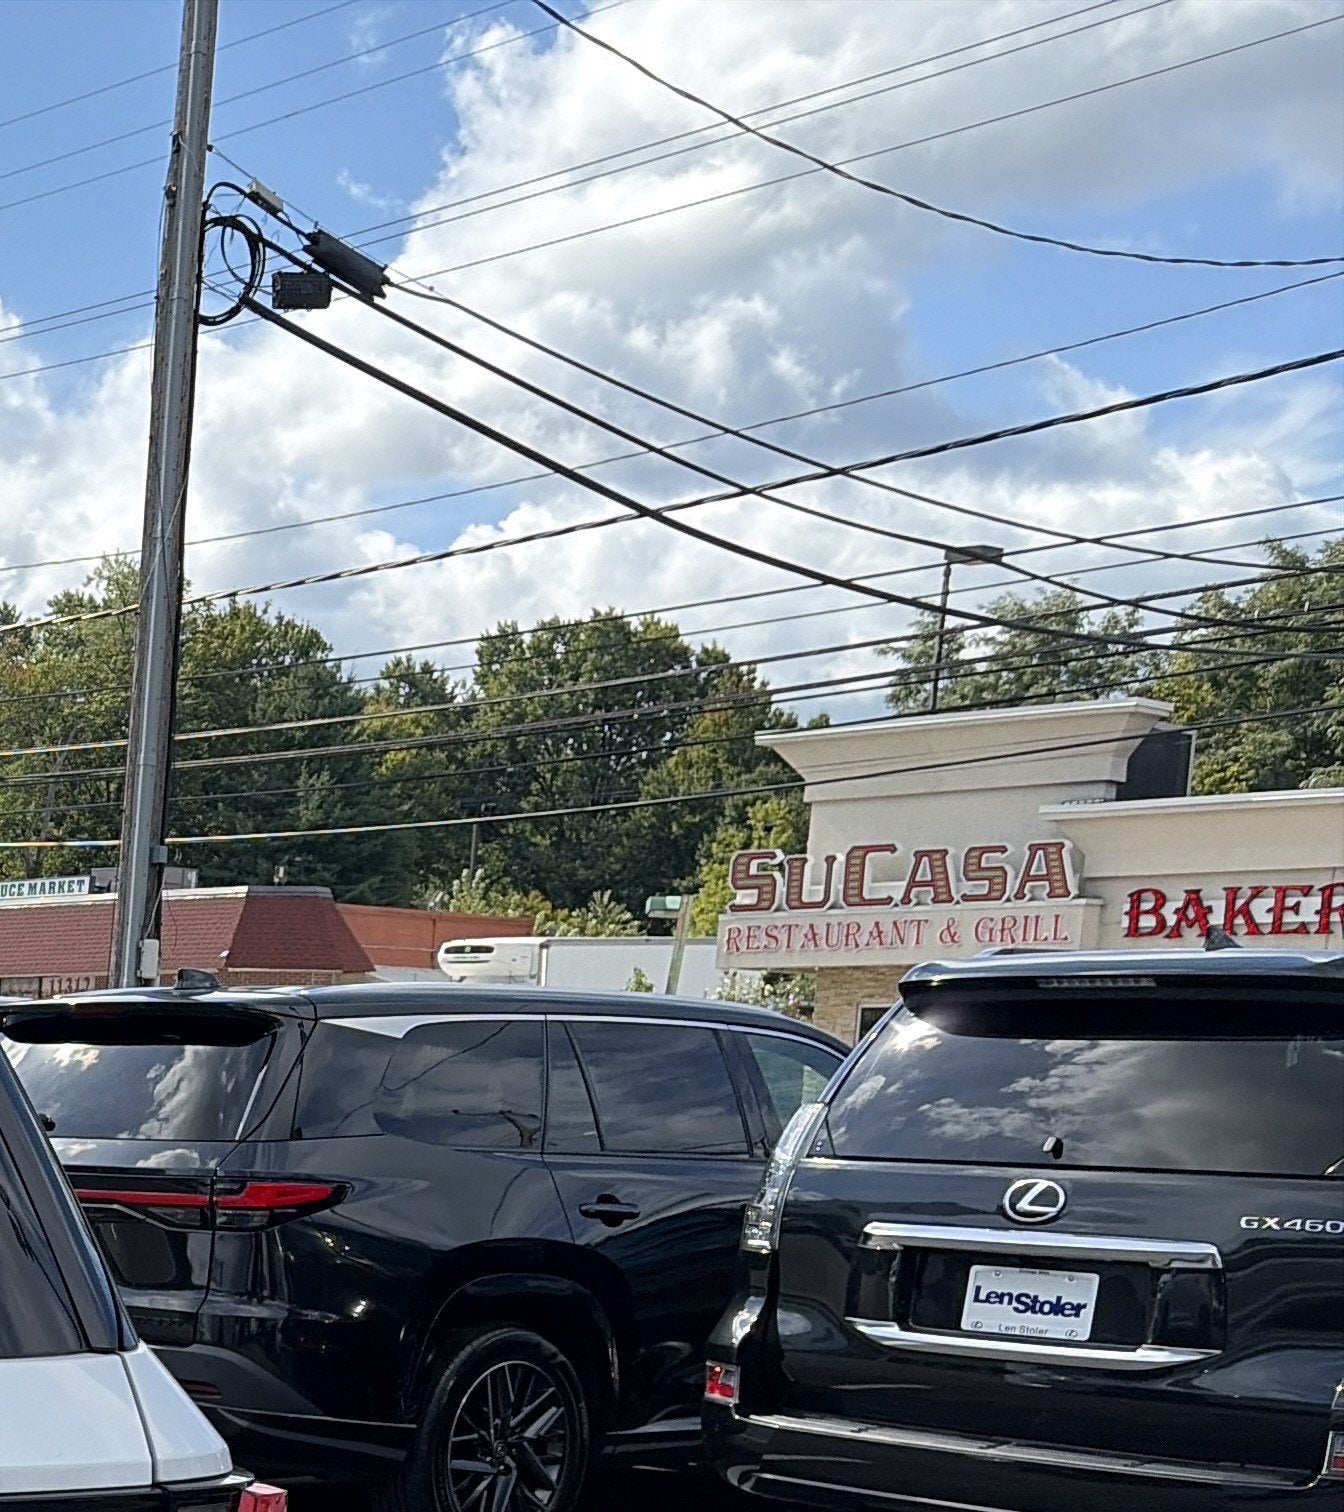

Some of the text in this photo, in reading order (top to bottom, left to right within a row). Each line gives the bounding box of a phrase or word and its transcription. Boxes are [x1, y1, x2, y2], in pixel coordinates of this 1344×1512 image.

[27, 879, 86, 896] MARKET
[725, 913, 1069, 953] RESTAURANT & GRILL
[1239, 1215, 1344, 1234] GX460
[998, 1321, 1049, 1336] Len Stoler
